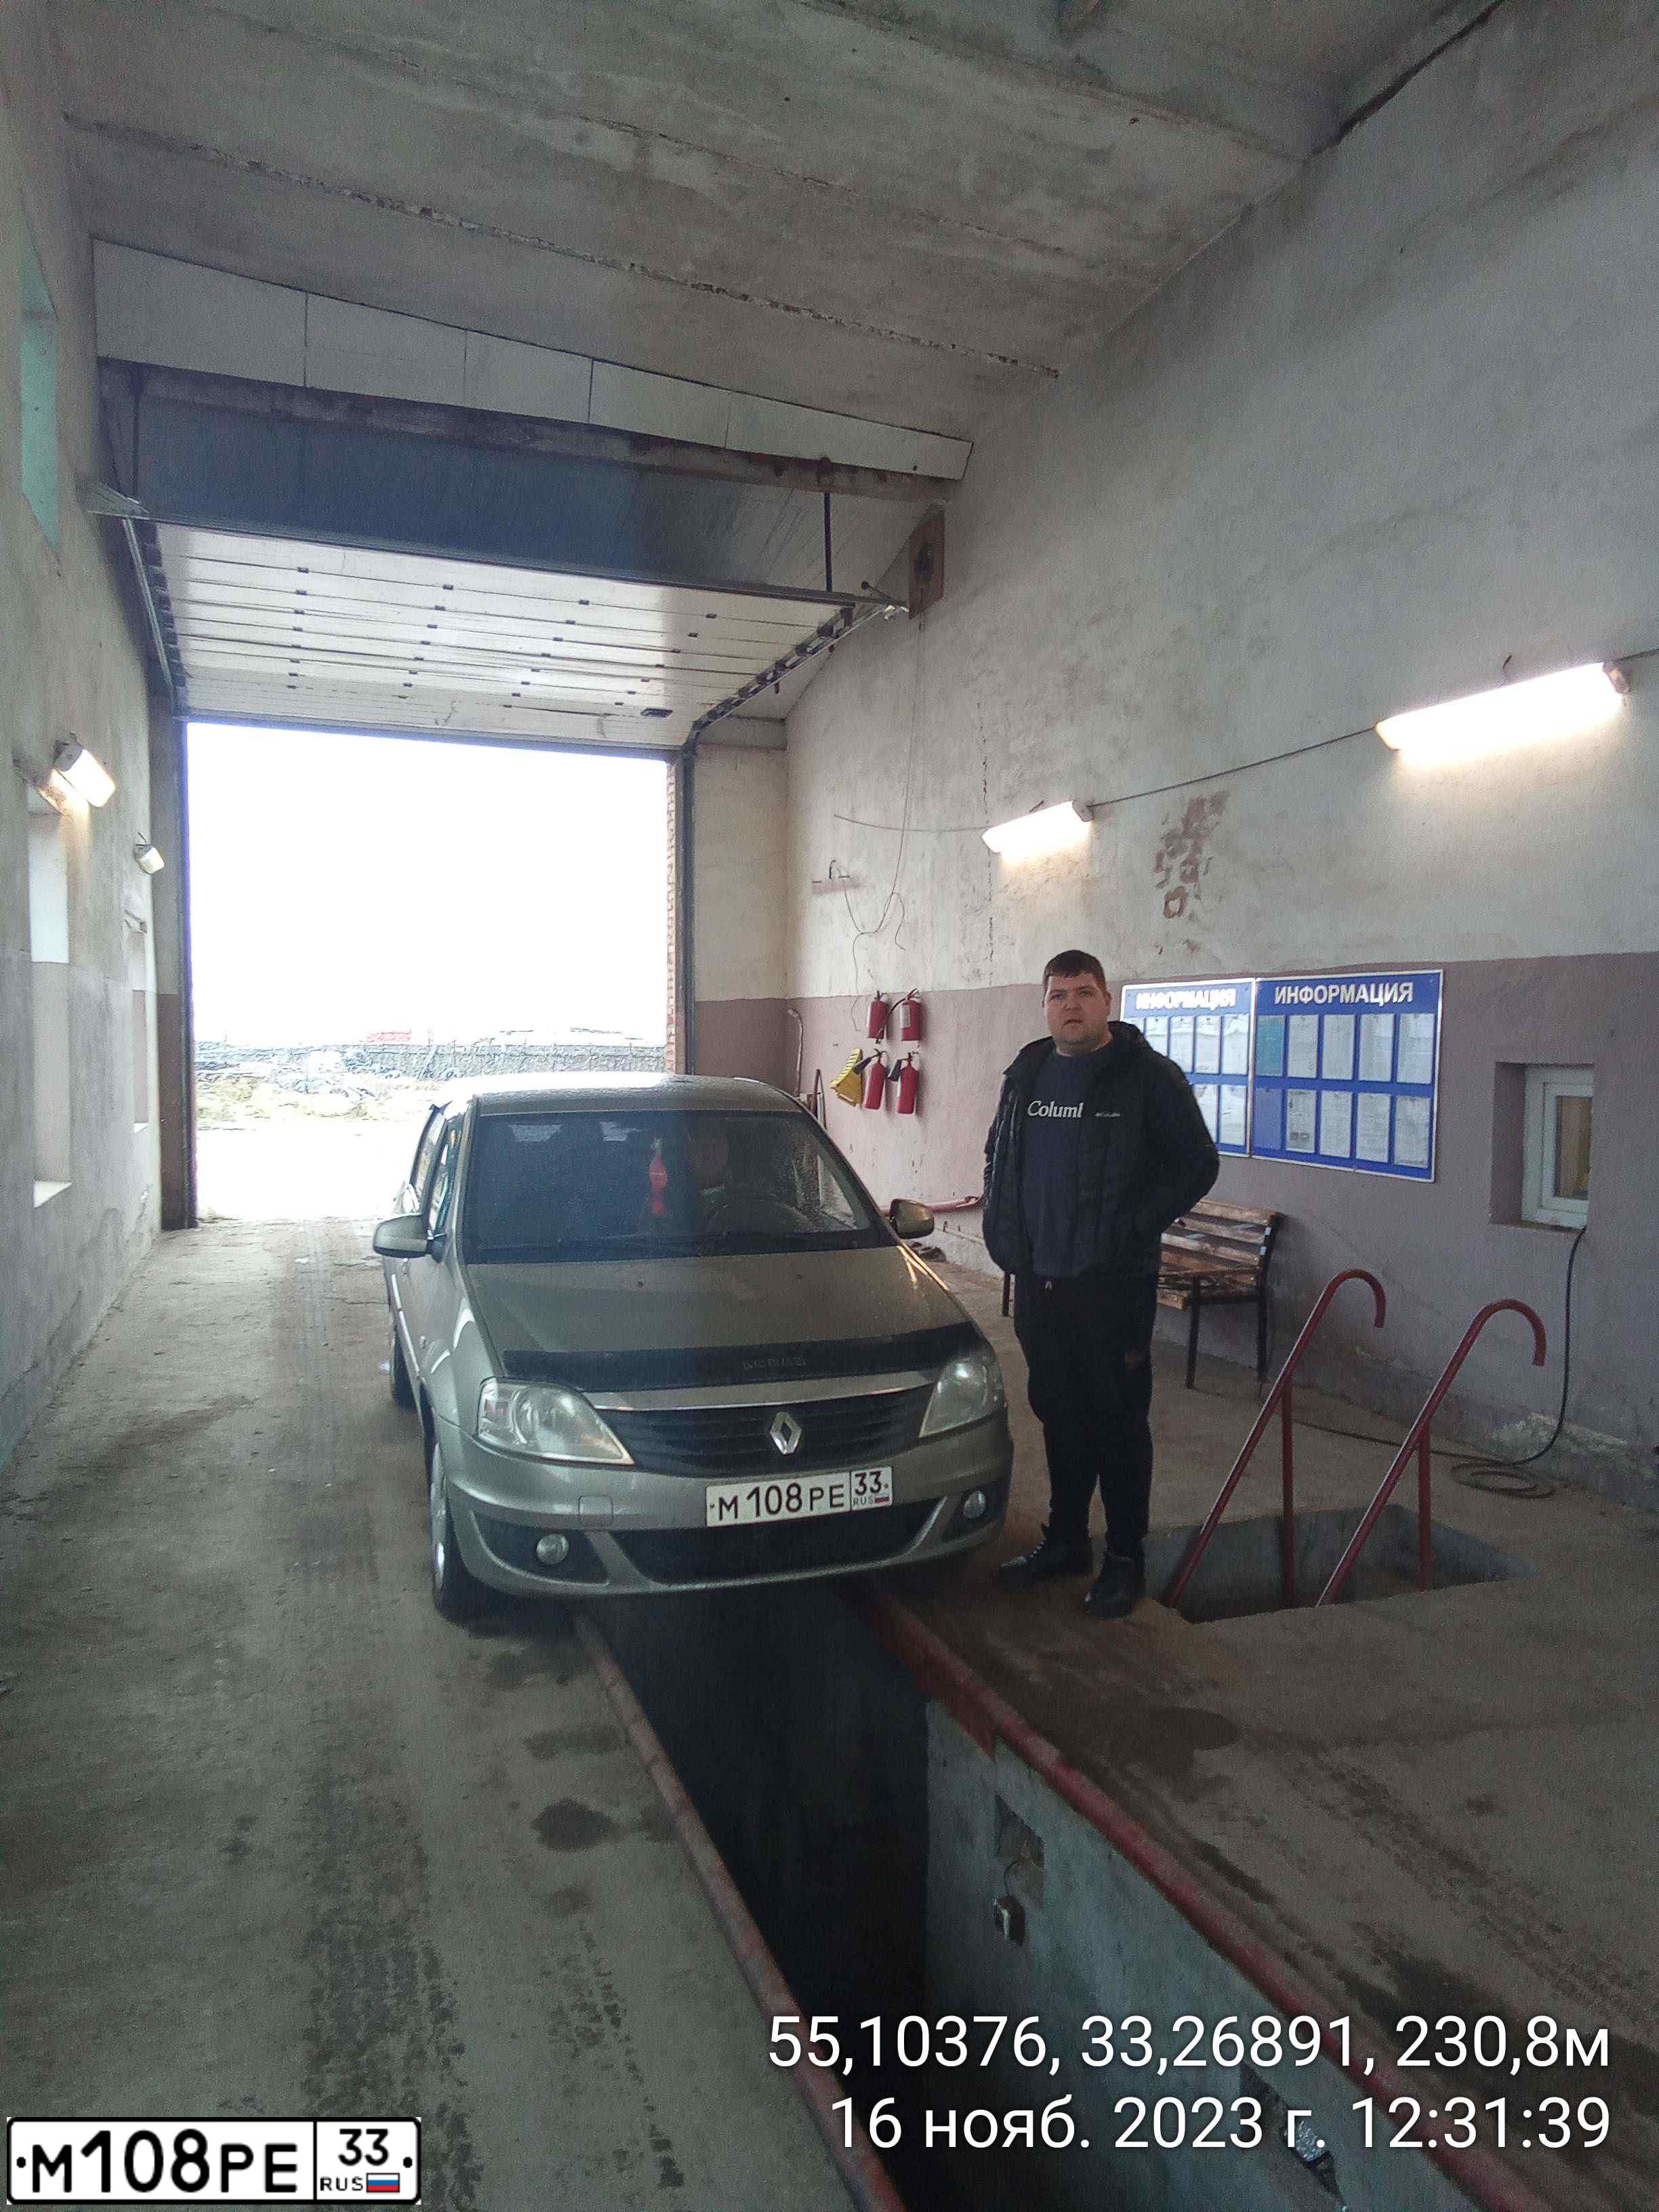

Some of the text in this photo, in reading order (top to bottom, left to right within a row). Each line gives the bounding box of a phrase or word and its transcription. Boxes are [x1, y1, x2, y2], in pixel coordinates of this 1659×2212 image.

[1136, 988, 1236, 1010] ИНФОРМАЦИЯ
[1275, 982, 1414, 1007] ИНФОРМАЦИЯ
[718, 1471, 882, 1521] М108РЕ 33
[853, 1496, 874, 1507] RUS
